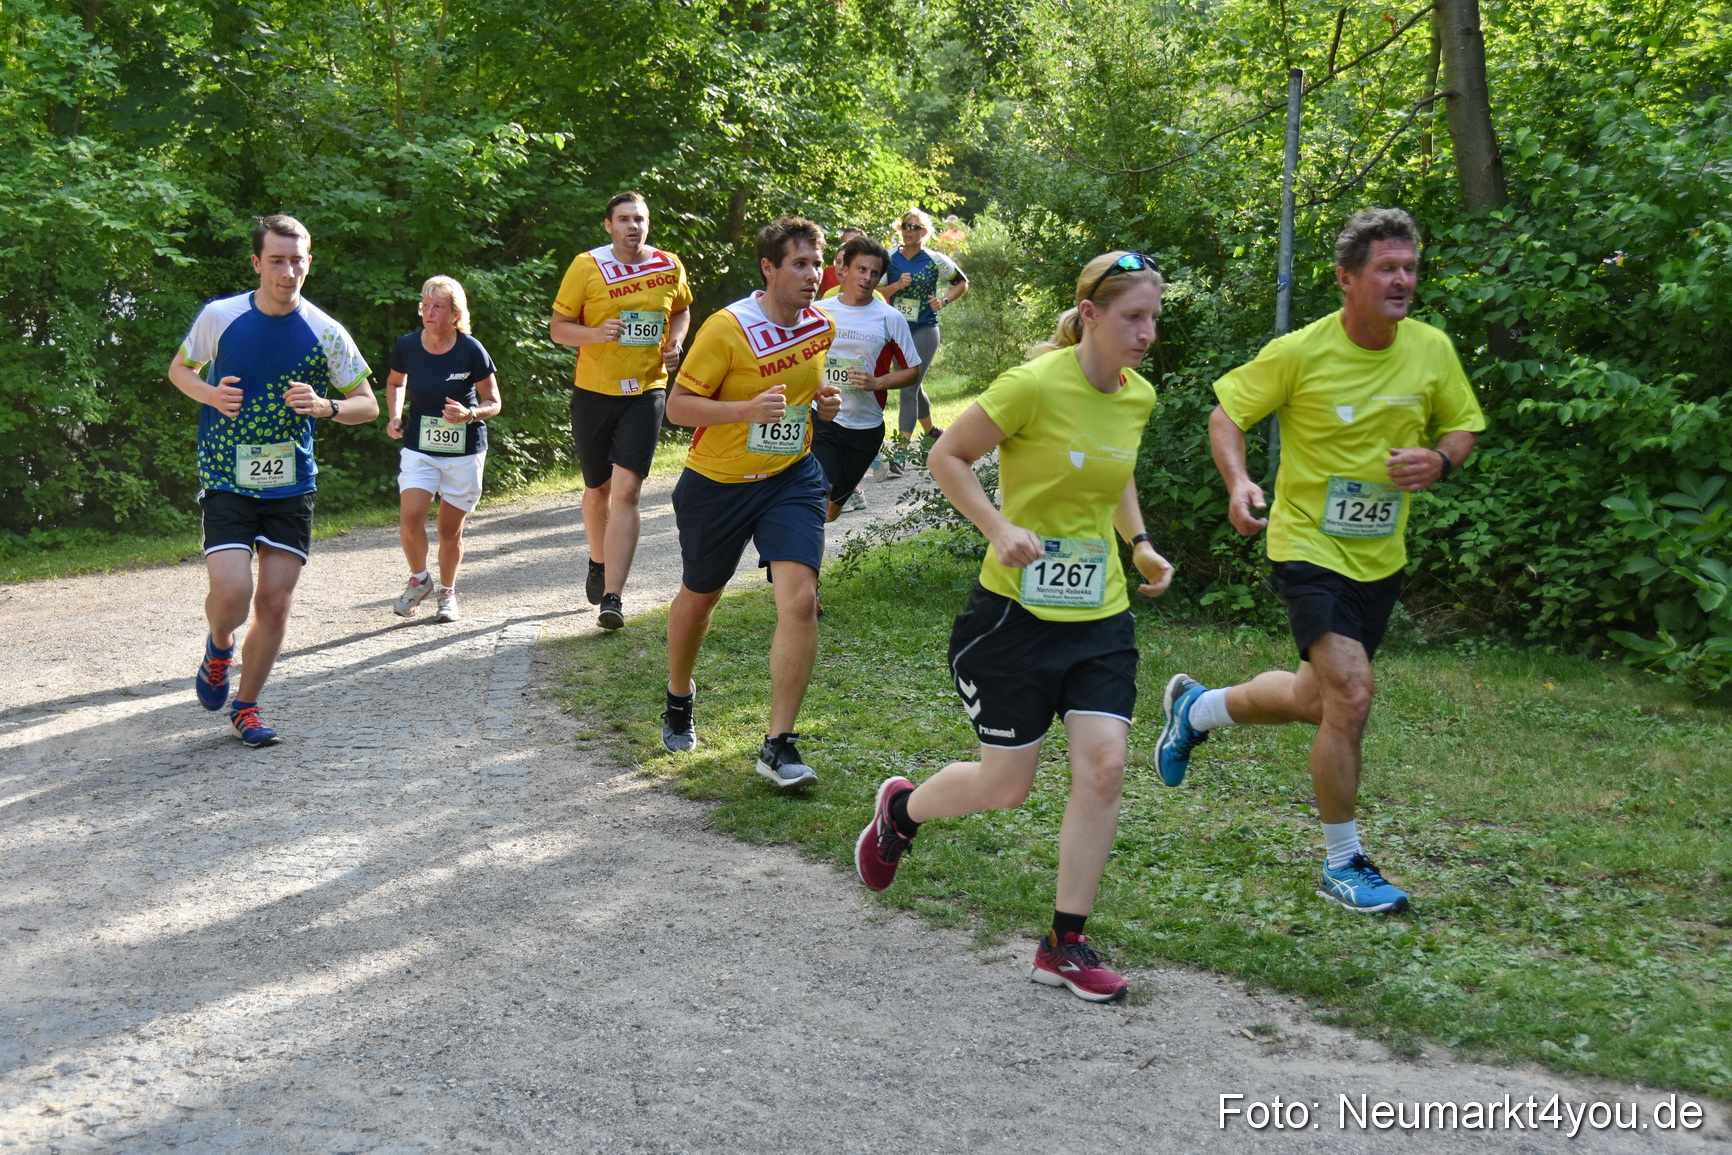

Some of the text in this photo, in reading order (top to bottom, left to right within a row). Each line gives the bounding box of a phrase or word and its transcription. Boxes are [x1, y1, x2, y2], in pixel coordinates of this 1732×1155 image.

[608, 274, 679, 299] MAX BÖGL
[627, 323, 659, 337] 1560
[759, 353, 800, 378] MAX
[825, 368, 849, 382] 109
[425, 428, 460, 444] 1390
[758, 422, 801, 441] 1633
[250, 459, 284, 476] 242
[1335, 499, 1393, 522] 1245
[1034, 561, 1097, 588] 1267
[1036, 586, 1092, 595] Nenning Rebekka
[978, 723, 1016, 738] hummel
